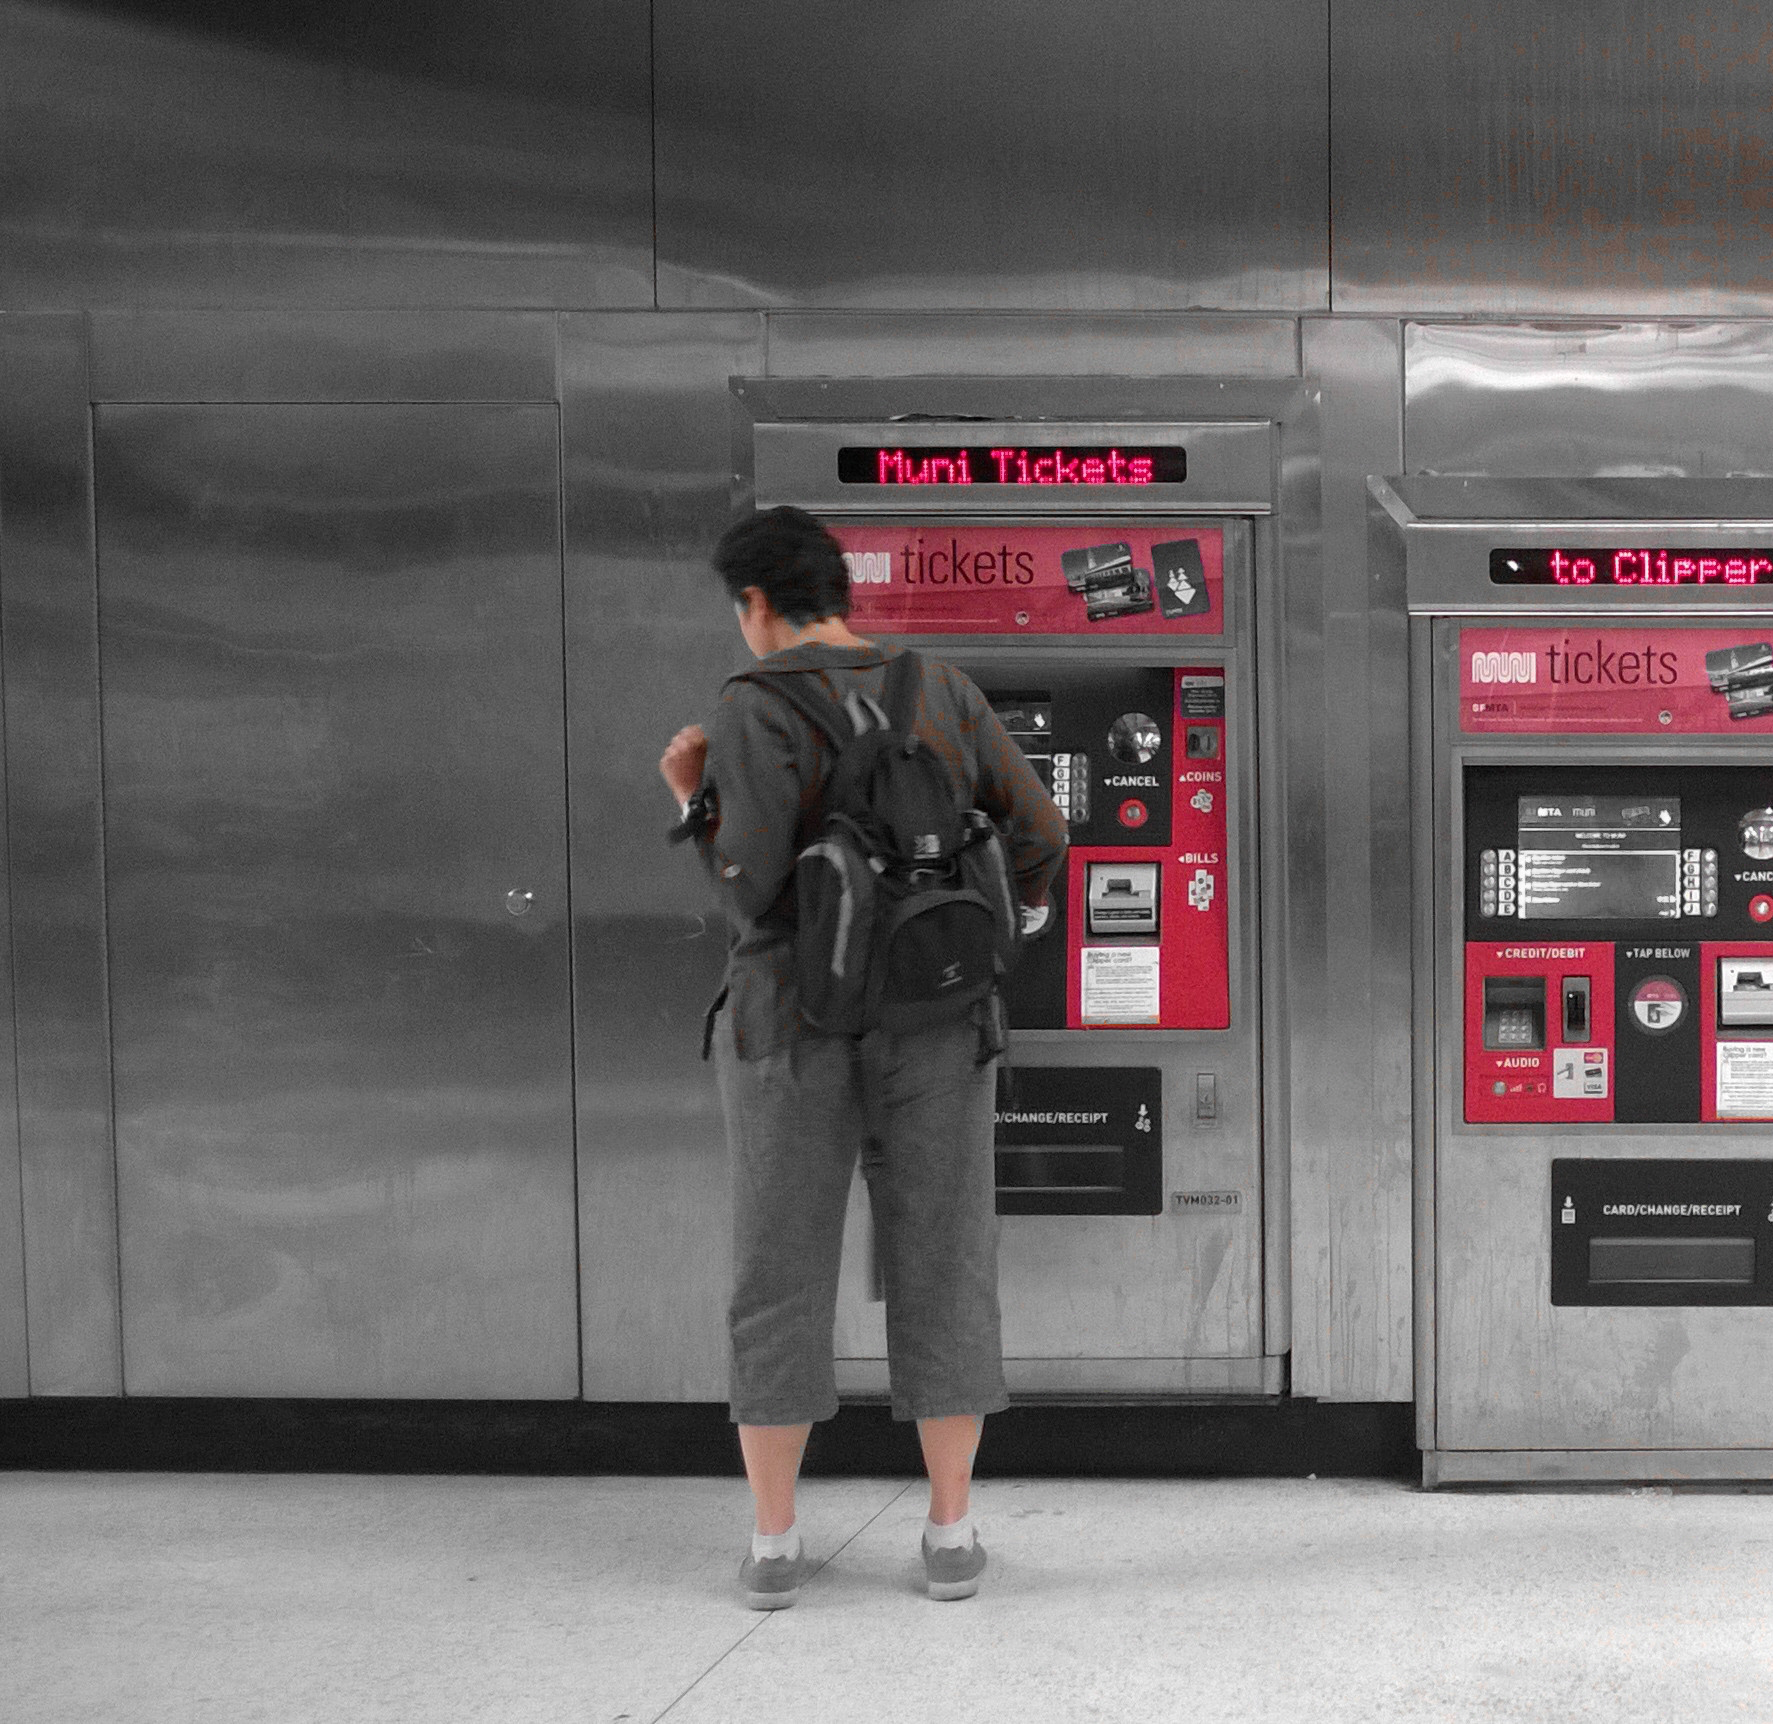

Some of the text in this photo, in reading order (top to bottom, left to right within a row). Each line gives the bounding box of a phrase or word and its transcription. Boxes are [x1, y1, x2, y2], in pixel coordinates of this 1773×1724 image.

[877, 449, 1153, 485] Muni Tickets
[900, 538, 1035, 585] tickets
[1550, 550, 1773, 585] to Clipper
[1545, 638, 1679, 685] tickets
[1112, 775, 1160, 788] CANCEL
[1186, 771, 1222, 783] COINS
[1185, 852, 1219, 864] BILLS
[1505, 948, 1586, 959] CREDIT/DEBIT
[1634, 948, 1690, 959] TAP BELOW
[1503, 1058, 1540, 1068] AUDIO
[1175, 1195, 1239, 1206] TVM032-01
[1603, 1204, 1742, 1217] CARD/CHANGE/RECEIPT
